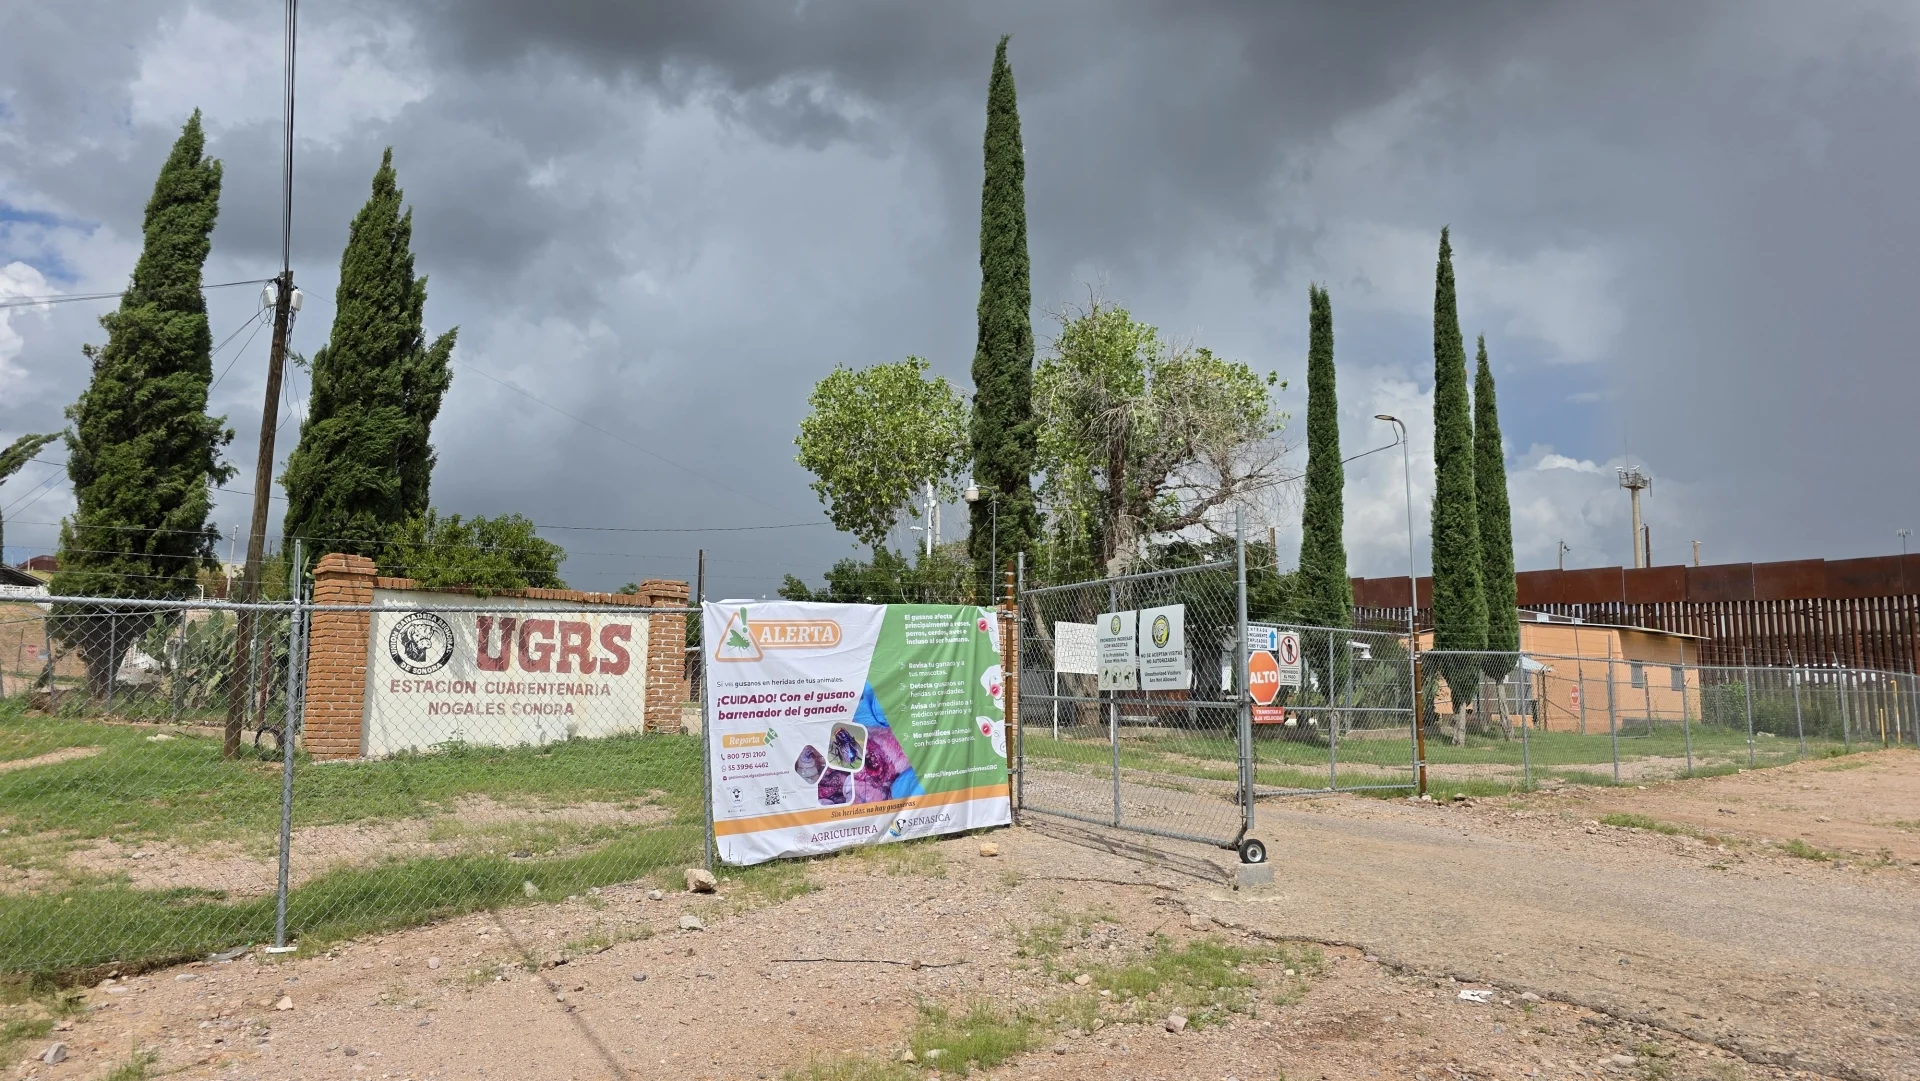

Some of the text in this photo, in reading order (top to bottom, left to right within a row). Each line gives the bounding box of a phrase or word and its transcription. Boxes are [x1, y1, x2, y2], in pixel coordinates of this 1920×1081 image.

[390, 613, 454, 654] UNION GANADERA REGIONAL
[760, 626, 834, 643] ALERTA
[476, 616, 632, 676] UGRS
[400, 662, 442, 674] DE SONORA
[1250, 671, 1277, 684] ALTO
[390, 680, 611, 696] ESTACION CUARENTENARIA
[717, 690, 855, 707] ¡CUIDADO! Con el gusano
[428, 702, 574, 716] NOGALES SONORA
[718, 704, 847, 720] barrenador del ganado.
[729, 736, 760, 746] Reporta
[811, 824, 879, 842] AGRICULTURA
[908, 813, 950, 826] SENASICA
